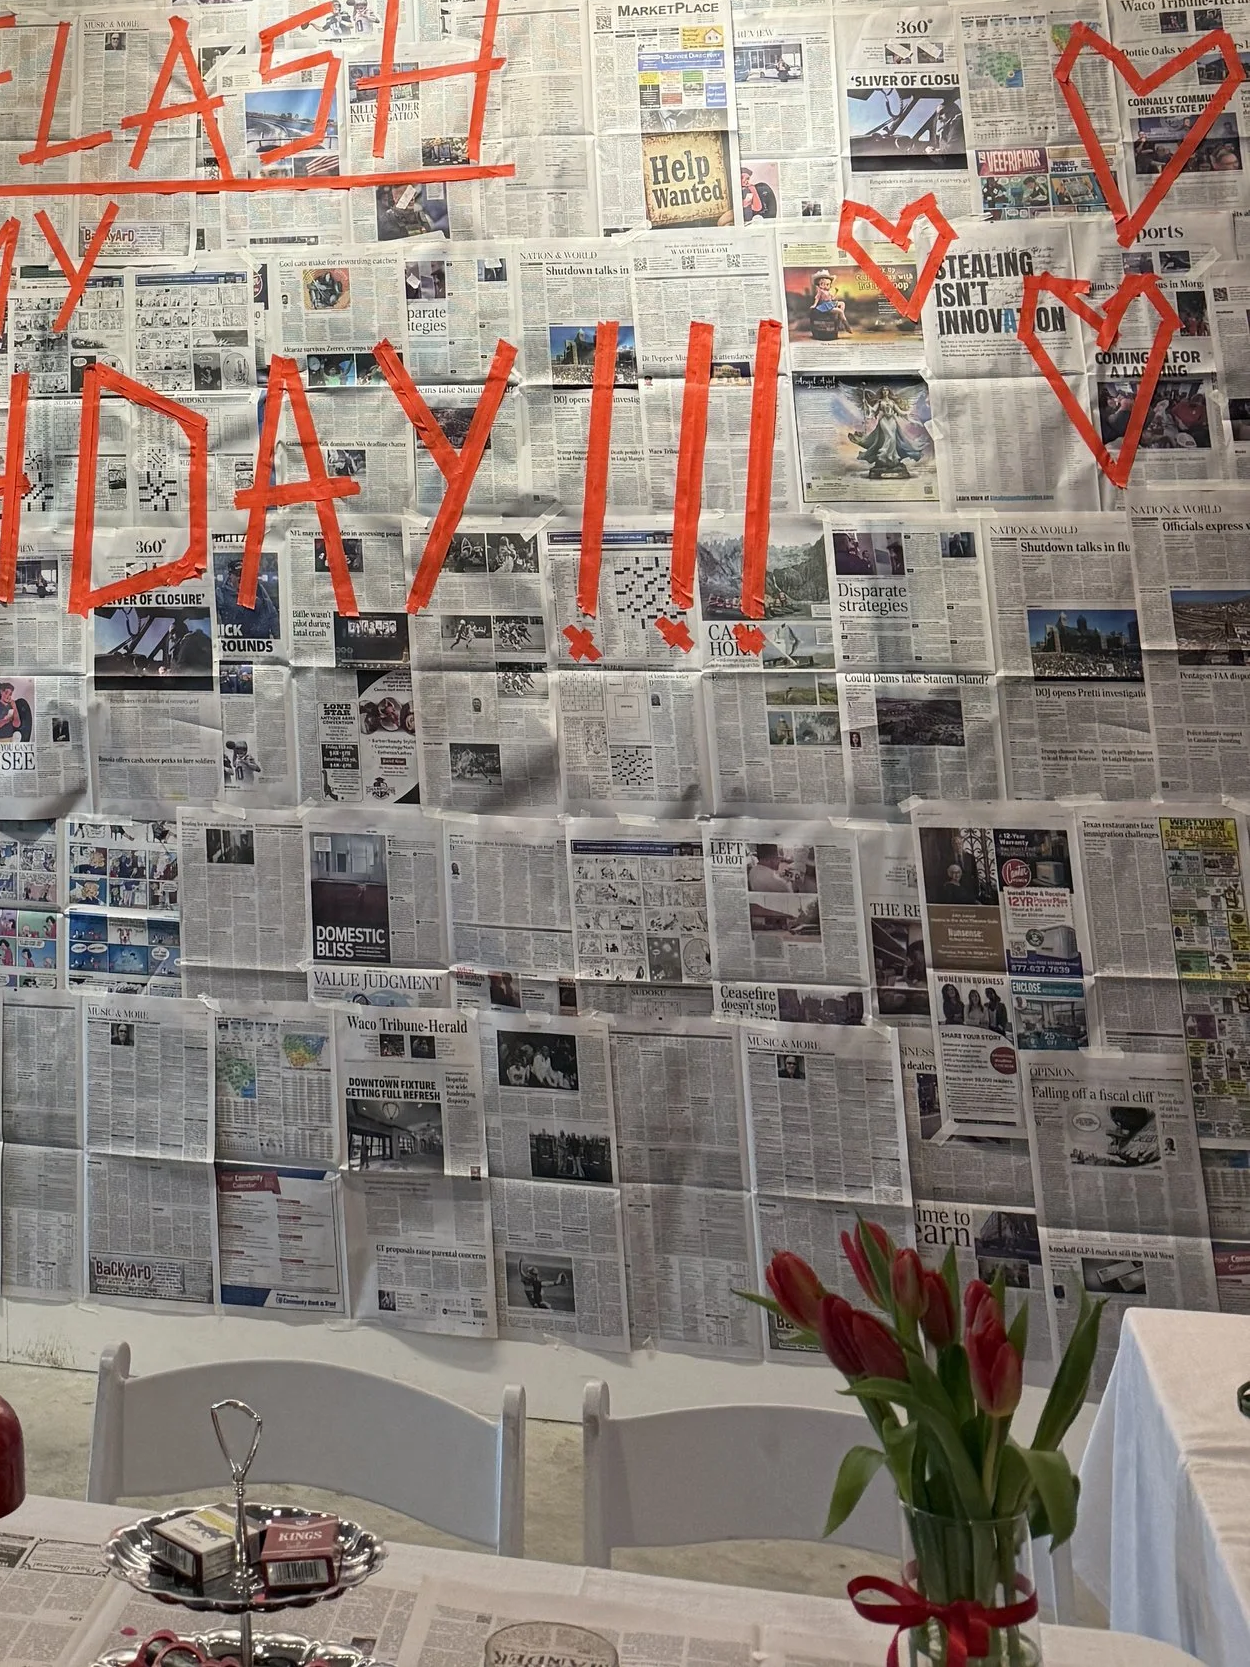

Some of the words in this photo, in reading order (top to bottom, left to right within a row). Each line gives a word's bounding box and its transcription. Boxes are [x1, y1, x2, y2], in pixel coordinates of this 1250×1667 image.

[618, 2, 719, 17] MARKETPLACE
[1121, 0, 1156, 13] Waco
[896, 18, 933, 34] 360°
[851, 74, 898, 87] 'SLIVER
[901, 74, 916, 86] OF
[650, 150, 711, 186] Help
[986, 150, 1041, 172] VEEFRIENDS
[652, 179, 723, 209] Wanted
[935, 250, 1034, 280] STEALING
[934, 283, 988, 308] ISN'T
[1131, 505, 1169, 514] NATION
[1172, 505, 1180, 513] &
[1182, 505, 1222, 514] WORLD
[1162, 520, 1203, 532] Officials
[1206, 522, 1245, 535] express
[135, 538, 167, 554] 360°
[1021, 542, 1073, 553] Shutdown
[1076, 542, 1102, 553] talks
[1104, 542, 1114, 552] in
[838, 582, 907, 598] Disparate
[139, 594, 153, 605] OF
[155, 593, 205, 606] CLOSURE'
[839, 598, 908, 613] strategies
[0, 743, 12, 751] YOU
[14, 743, 34, 751] CAN'T
[1083, 830, 1123, 838] immigration
[1125, 831, 1159, 839] challenges
[710, 842, 744, 855] LEFT
[711, 854, 724, 865] TO
[726, 855, 744, 865] ROT
[316, 925, 386, 944] DOMESTIC
[316, 942, 355, 958] BLISS
[314, 971, 358, 988] VALUE
[363, 973, 442, 991] JUDGMENT
[1012, 982, 1041, 993] ENCLOSE
[720, 984, 776, 1001] Ceasefire
[721, 1000, 753, 1011] doesn't
[756, 1000, 777, 1013] stop
[347, 1016, 377, 1030] Waco
[379, 1017, 468, 1033] Tribune-Herald
[748, 1036, 779, 1048] MUSIC
[781, 1038, 789, 1048] &
[792, 1040, 821, 1050] MORE
[1029, 1066, 1075, 1078] OPINION
[349, 1077, 399, 1089] DOWNTOWN
[401, 1080, 436, 1090] FIXTURE
[346, 1088, 380, 1098] GETTING
[382, 1090, 402, 1098] FULL
[403, 1091, 440, 1101] REFRESH
[1031, 1086, 1070, 1103] Falling
[1072, 1087, 1087, 1100] off
[1090, 1091, 1098, 1101] a
[1099, 1088, 1130, 1102] fiscal
[1132, 1089, 1155, 1104] cliff
[278, 1530, 323, 1543] KINGS
